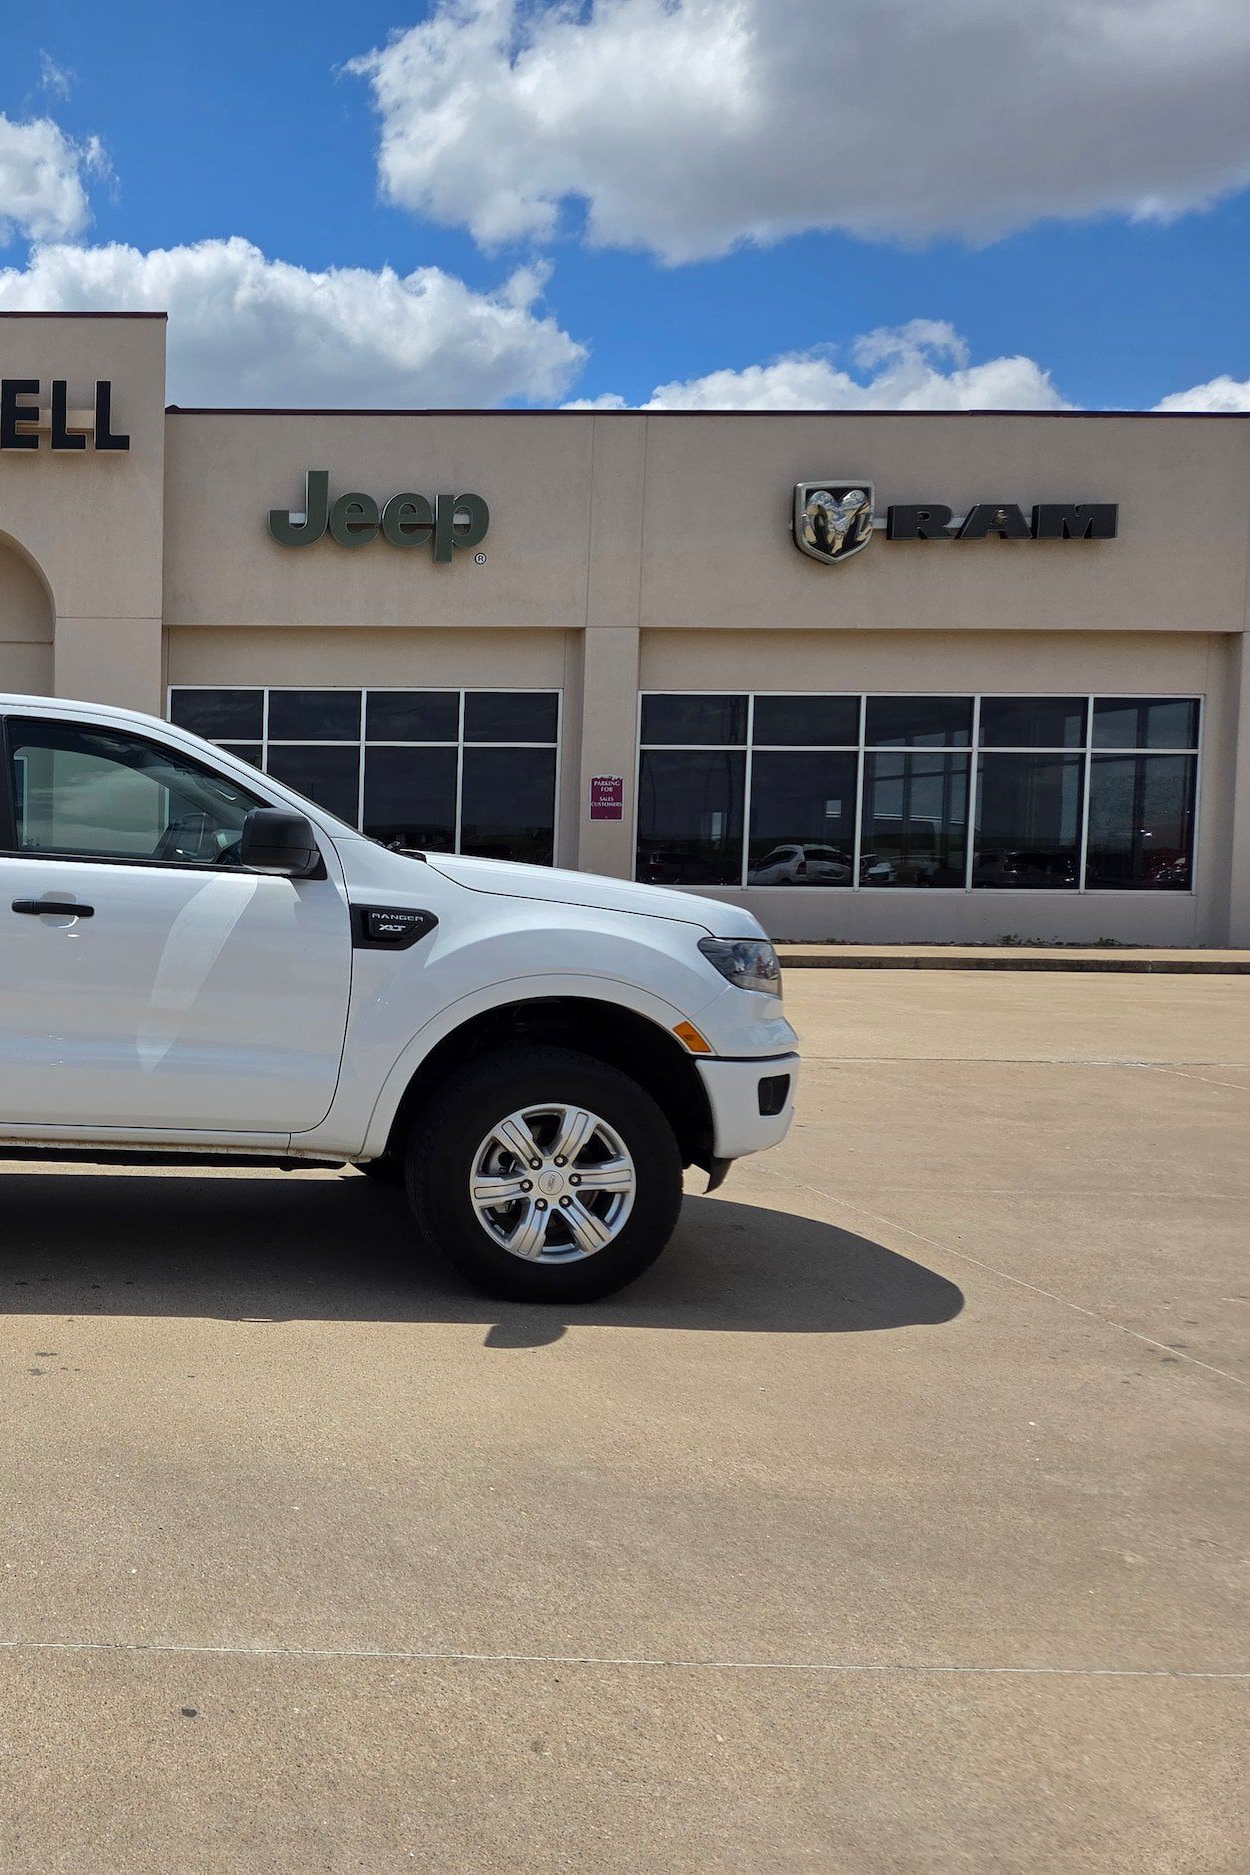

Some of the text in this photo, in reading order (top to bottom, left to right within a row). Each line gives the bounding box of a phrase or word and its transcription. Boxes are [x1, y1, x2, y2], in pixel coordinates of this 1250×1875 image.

[268, 470, 490, 563] Jeep
[886, 503, 1120, 540] RAM
[372, 913, 424, 922] RANGER
